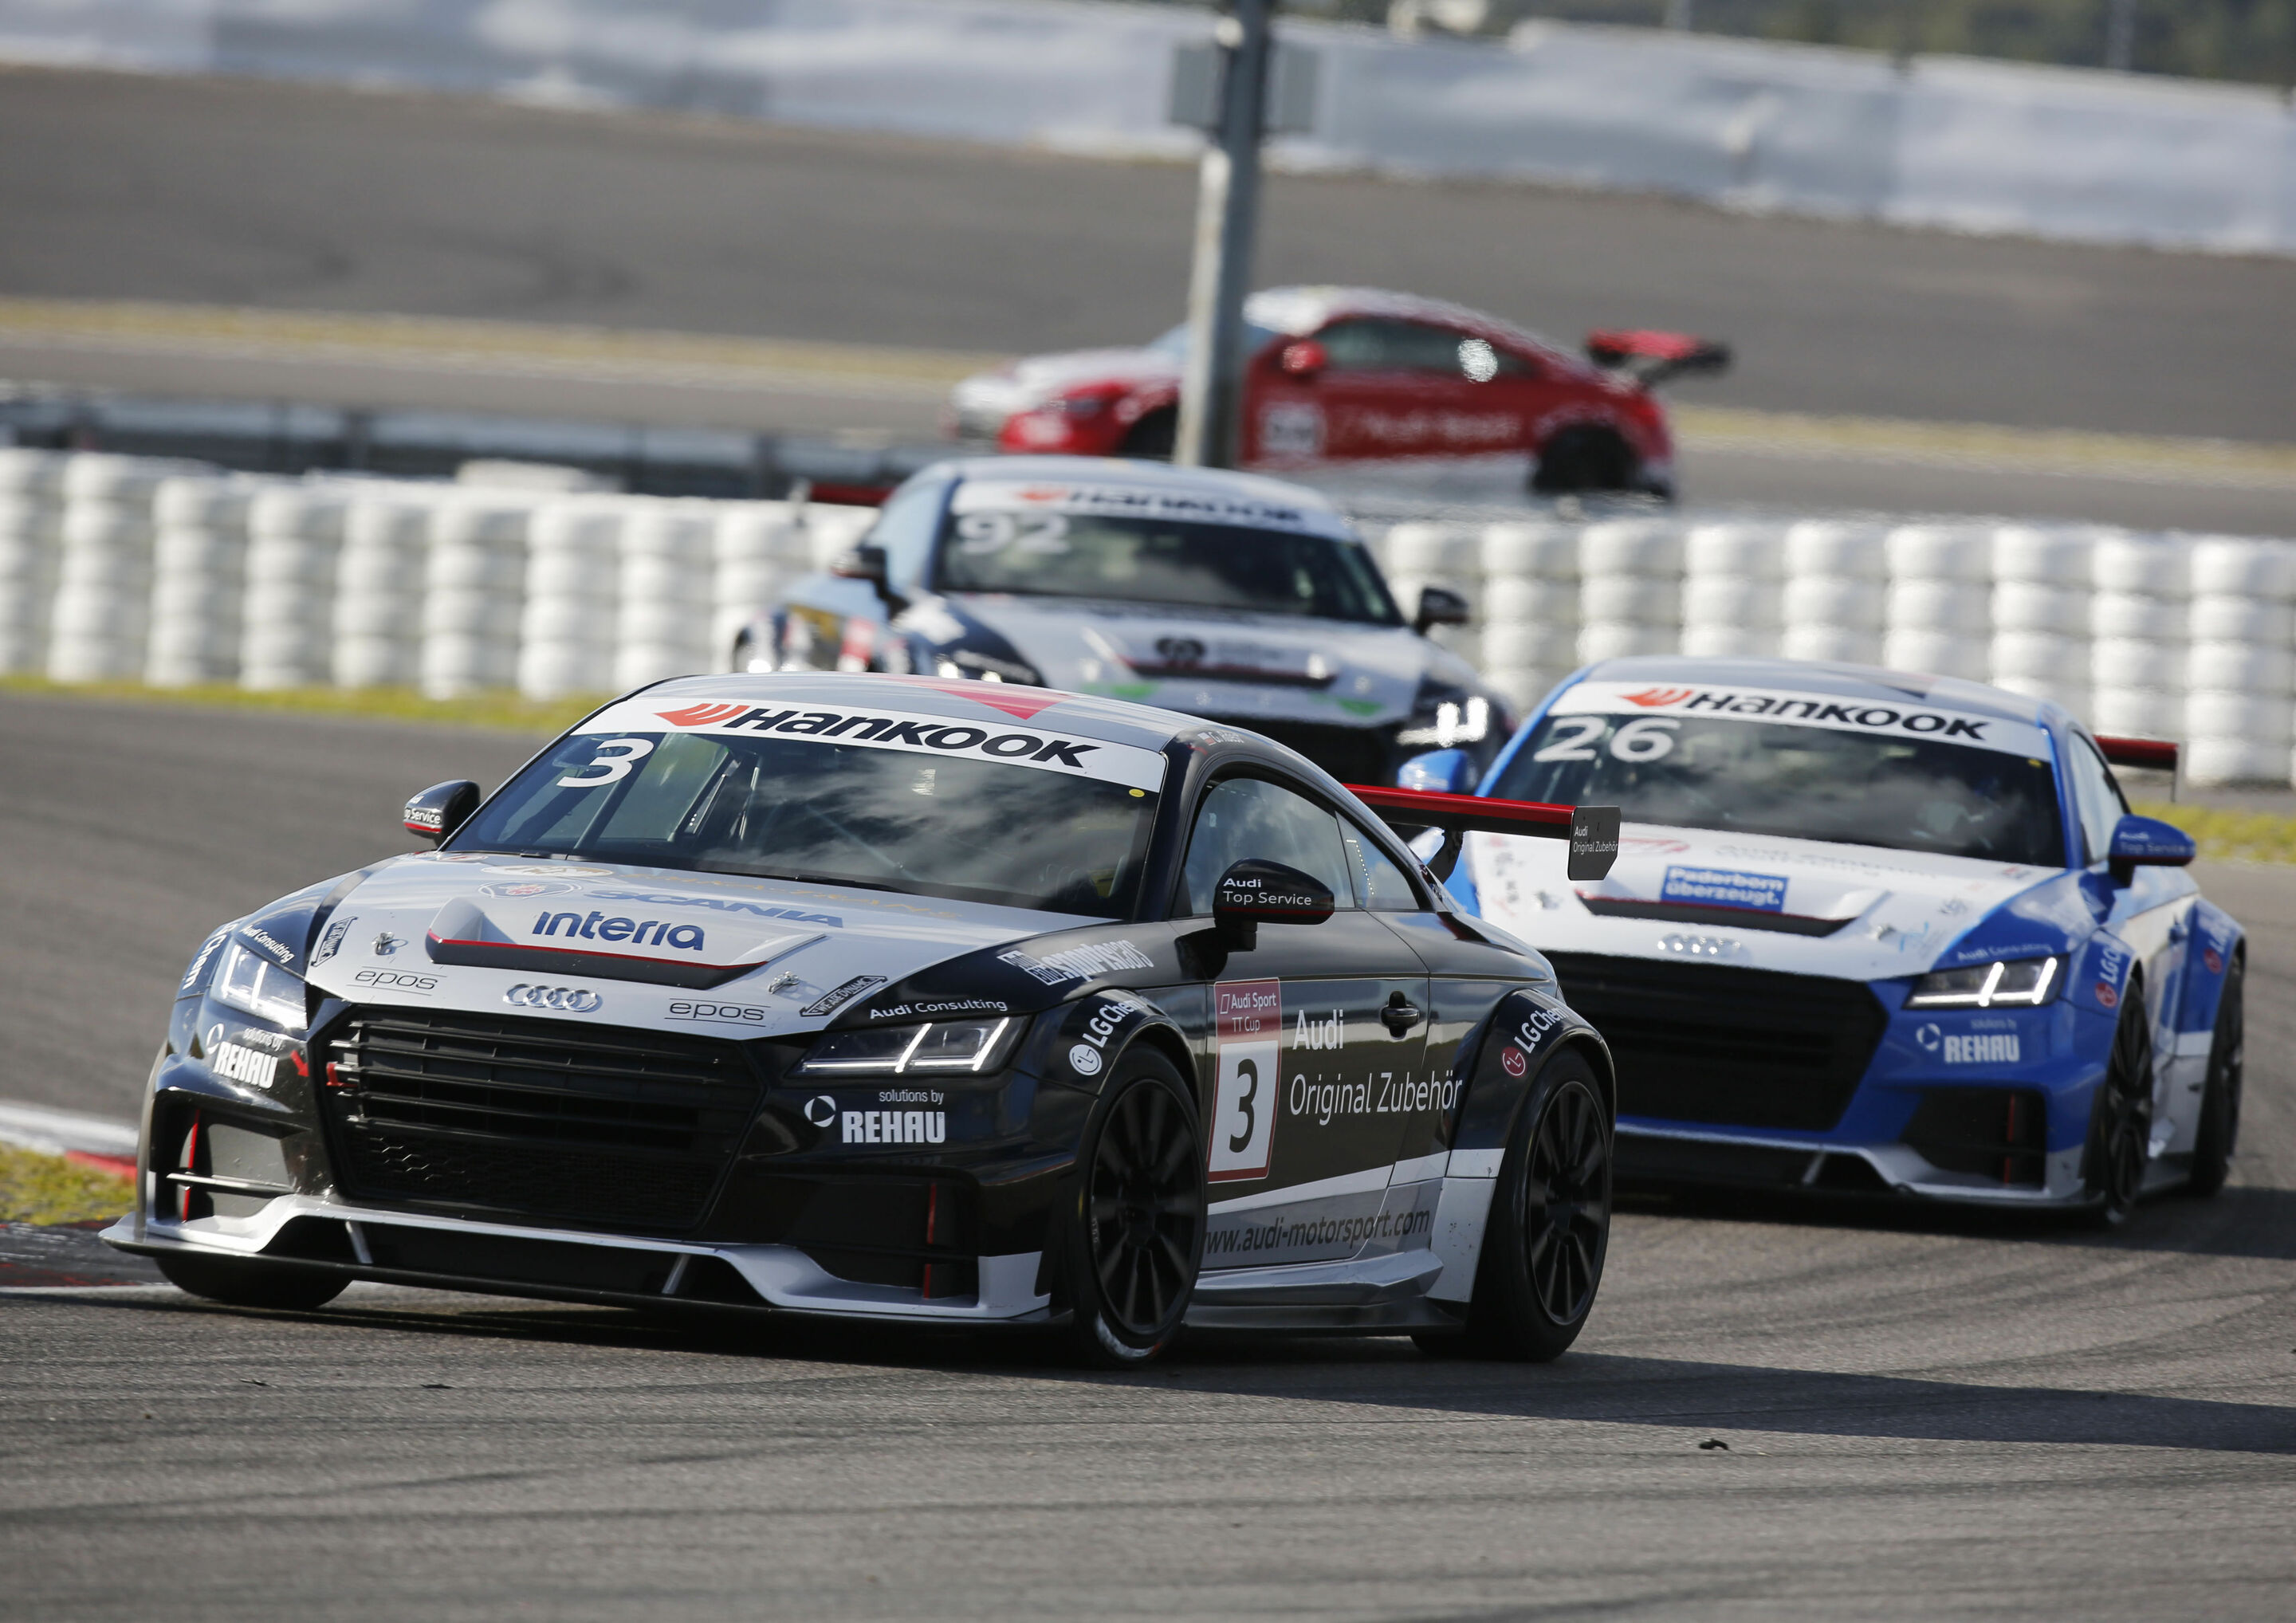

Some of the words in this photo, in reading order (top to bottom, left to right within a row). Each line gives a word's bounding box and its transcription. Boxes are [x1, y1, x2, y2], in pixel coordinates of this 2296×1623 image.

[957, 513, 1071, 556] 92
[1533, 717, 1681, 763] 26
[556, 738, 655, 788] 3
[1574, 825, 1588, 837] Audi
[1573, 841, 1594, 855] Original
[1223, 878, 1262, 888] Audi
[1668, 867, 1785, 893] Paderborn
[583, 889, 843, 929] SCANIA
[1222, 890, 1254, 906] Top
[1257, 892, 1312, 906] Service
[254, 931, 295, 965] Consulting
[355, 970, 438, 990] epos
[669, 999, 765, 1021] epos
[870, 1003, 911, 1020] Audi
[915, 999, 1008, 1014] Consulting
[1231, 992, 1251, 1009] Audi
[1252, 991, 1277, 1012] Sport
[1082, 1017, 1115, 1049] LG
[1099, 999, 1146, 1024] Chem
[1232, 1016, 1243, 1033] TT
[1244, 1016, 1260, 1035] Cup
[1292, 1008, 1344, 1051] Audi
[1514, 1022, 1542, 1054] LG
[1530, 1008, 1569, 1032] Chem
[1944, 1034, 2020, 1063] REHAU
[212, 1040, 279, 1090] REHAU
[879, 1090, 928, 1103] solutions
[931, 1090, 944, 1106] by
[1229, 1057, 1259, 1154] 3
[1290, 1072, 1373, 1126] Original
[1377, 1070, 1464, 1114] Zubehör
[842, 1110, 946, 1144] REHAU
